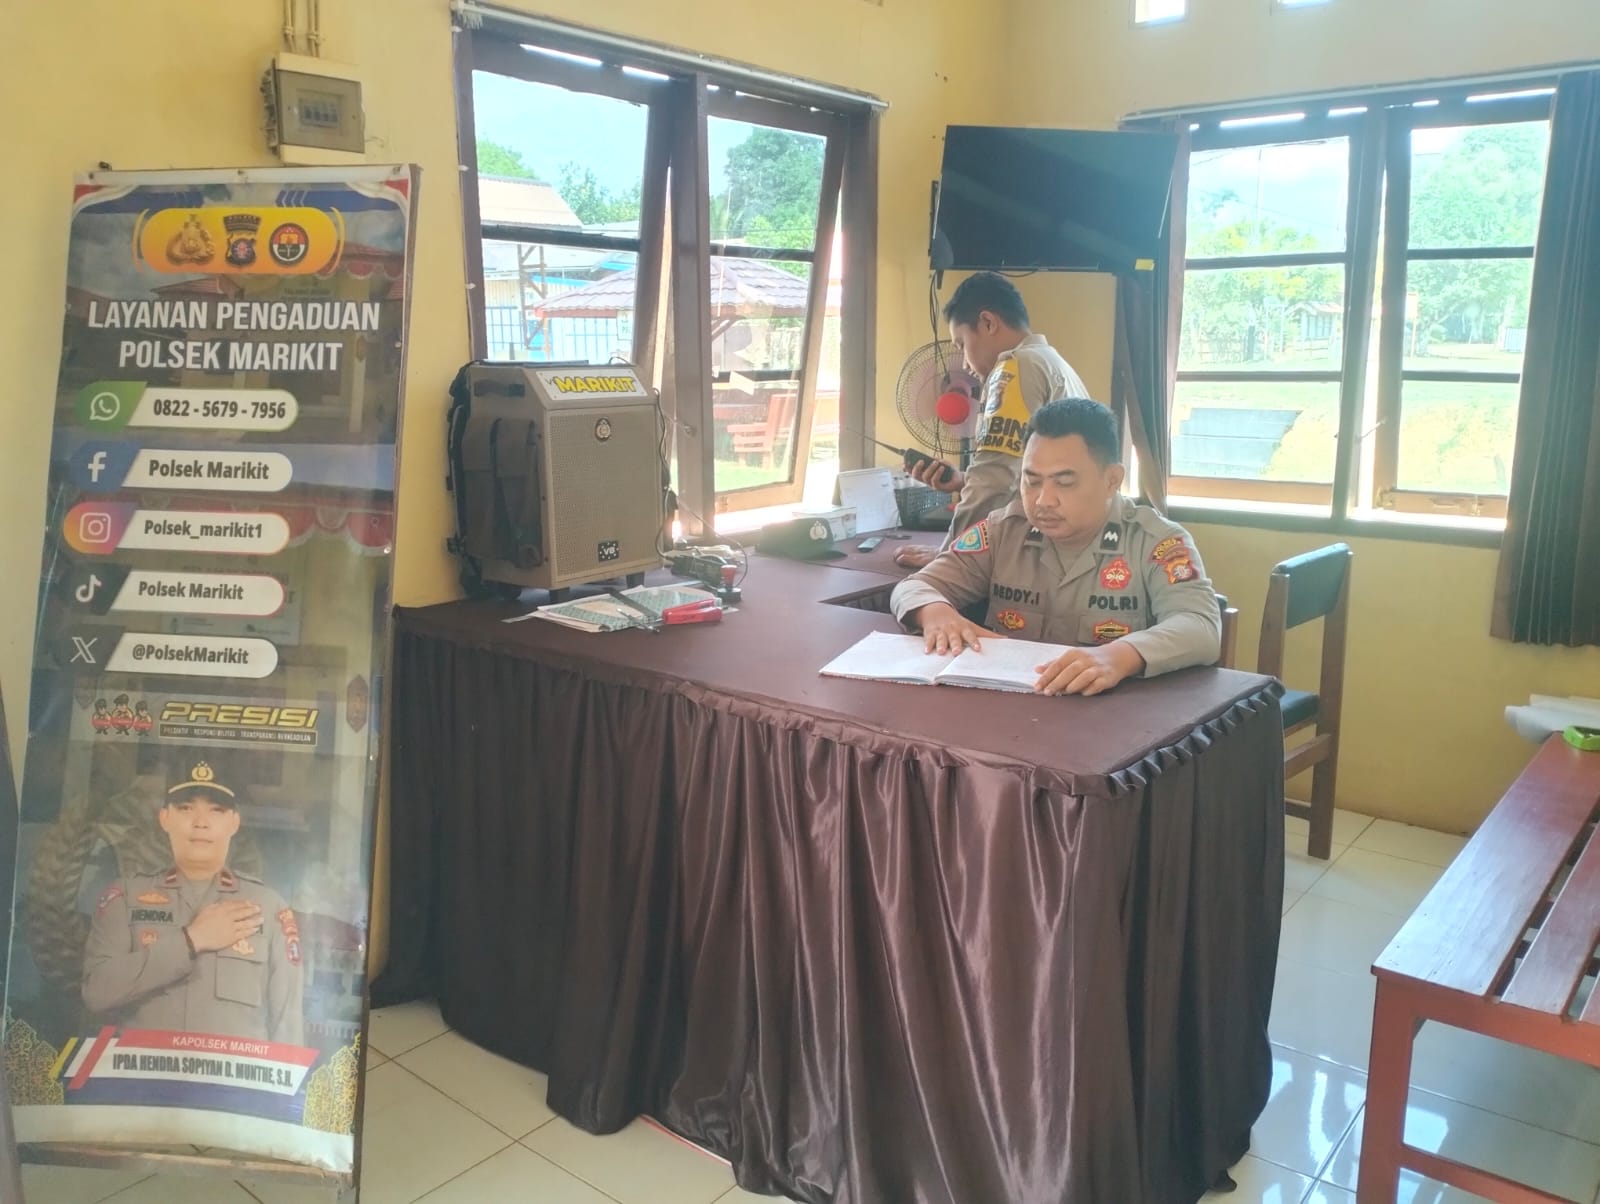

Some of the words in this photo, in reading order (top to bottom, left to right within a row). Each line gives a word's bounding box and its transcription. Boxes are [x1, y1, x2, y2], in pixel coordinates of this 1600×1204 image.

[88, 300, 207, 329] LAYANAN
[216, 302, 380, 331] PENGADUAN
[119, 340, 221, 369] POLSEK
[228, 343, 343, 371] MARIKIT
[553, 376, 637, 393] MARIKIT
[153, 398, 190, 417] 0822
[202, 400, 238, 418] 5679
[251, 401, 286, 419] 7956
[148, 459, 203, 478] Polsek
[206, 461, 270, 480] Marikit
[144, 519, 263, 540] Polsek_marikit1
[138, 581, 186, 597] Polsek
[188, 582, 244, 601] Marikit
[1088, 594, 1139, 611] POLRI
[132, 643, 249, 665] @PolsekMarikit
[161, 702, 318, 728] PRESISI
[131, 908, 174, 924] HENDRA
[172, 1036, 228, 1050] KAPOLSEK
[229, 1040, 270, 1055] MARIKIT
[113, 1053, 138, 1071] IPDA
[140, 1055, 180, 1073] HENDRA
[182, 1057, 223, 1077] SOPIYAN
[236, 1063, 275, 1085] MUNTHE,
